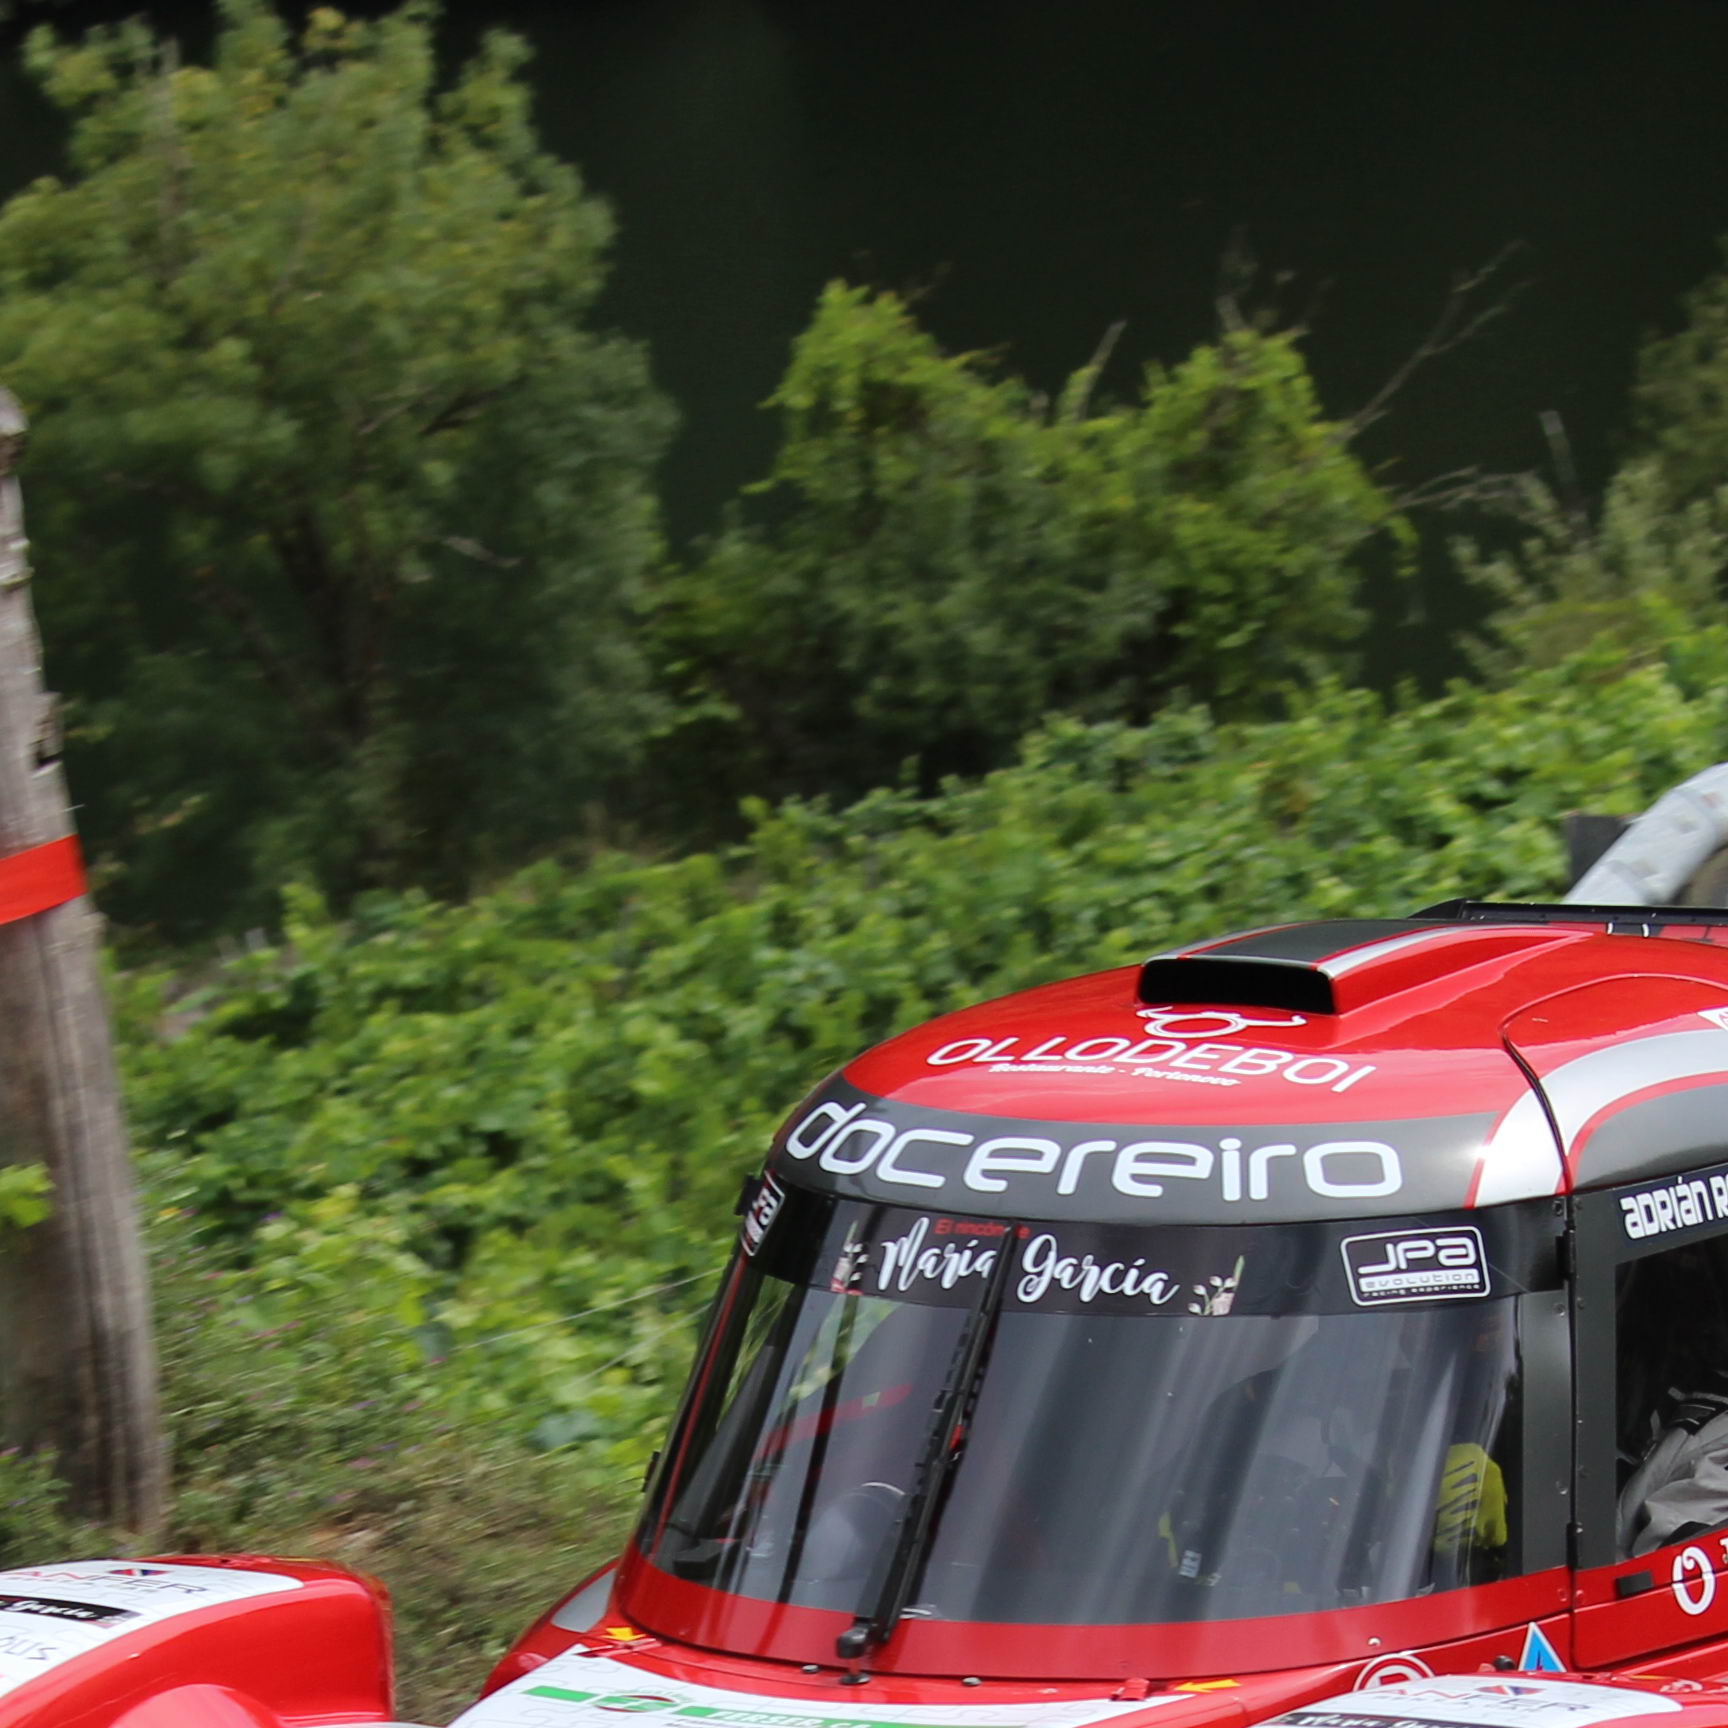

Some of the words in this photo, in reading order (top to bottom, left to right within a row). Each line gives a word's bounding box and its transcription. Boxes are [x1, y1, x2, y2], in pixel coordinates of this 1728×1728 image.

[926, 1037, 1376, 1092] OLLODEBOI
[786, 1100, 1402, 1201] docereiro
[878, 1216, 999, 1292] María
[1016, 1233, 1180, 1304] García
[1364, 1270, 1477, 1290] evolution
[1672, 1546, 1716, 1615] O
